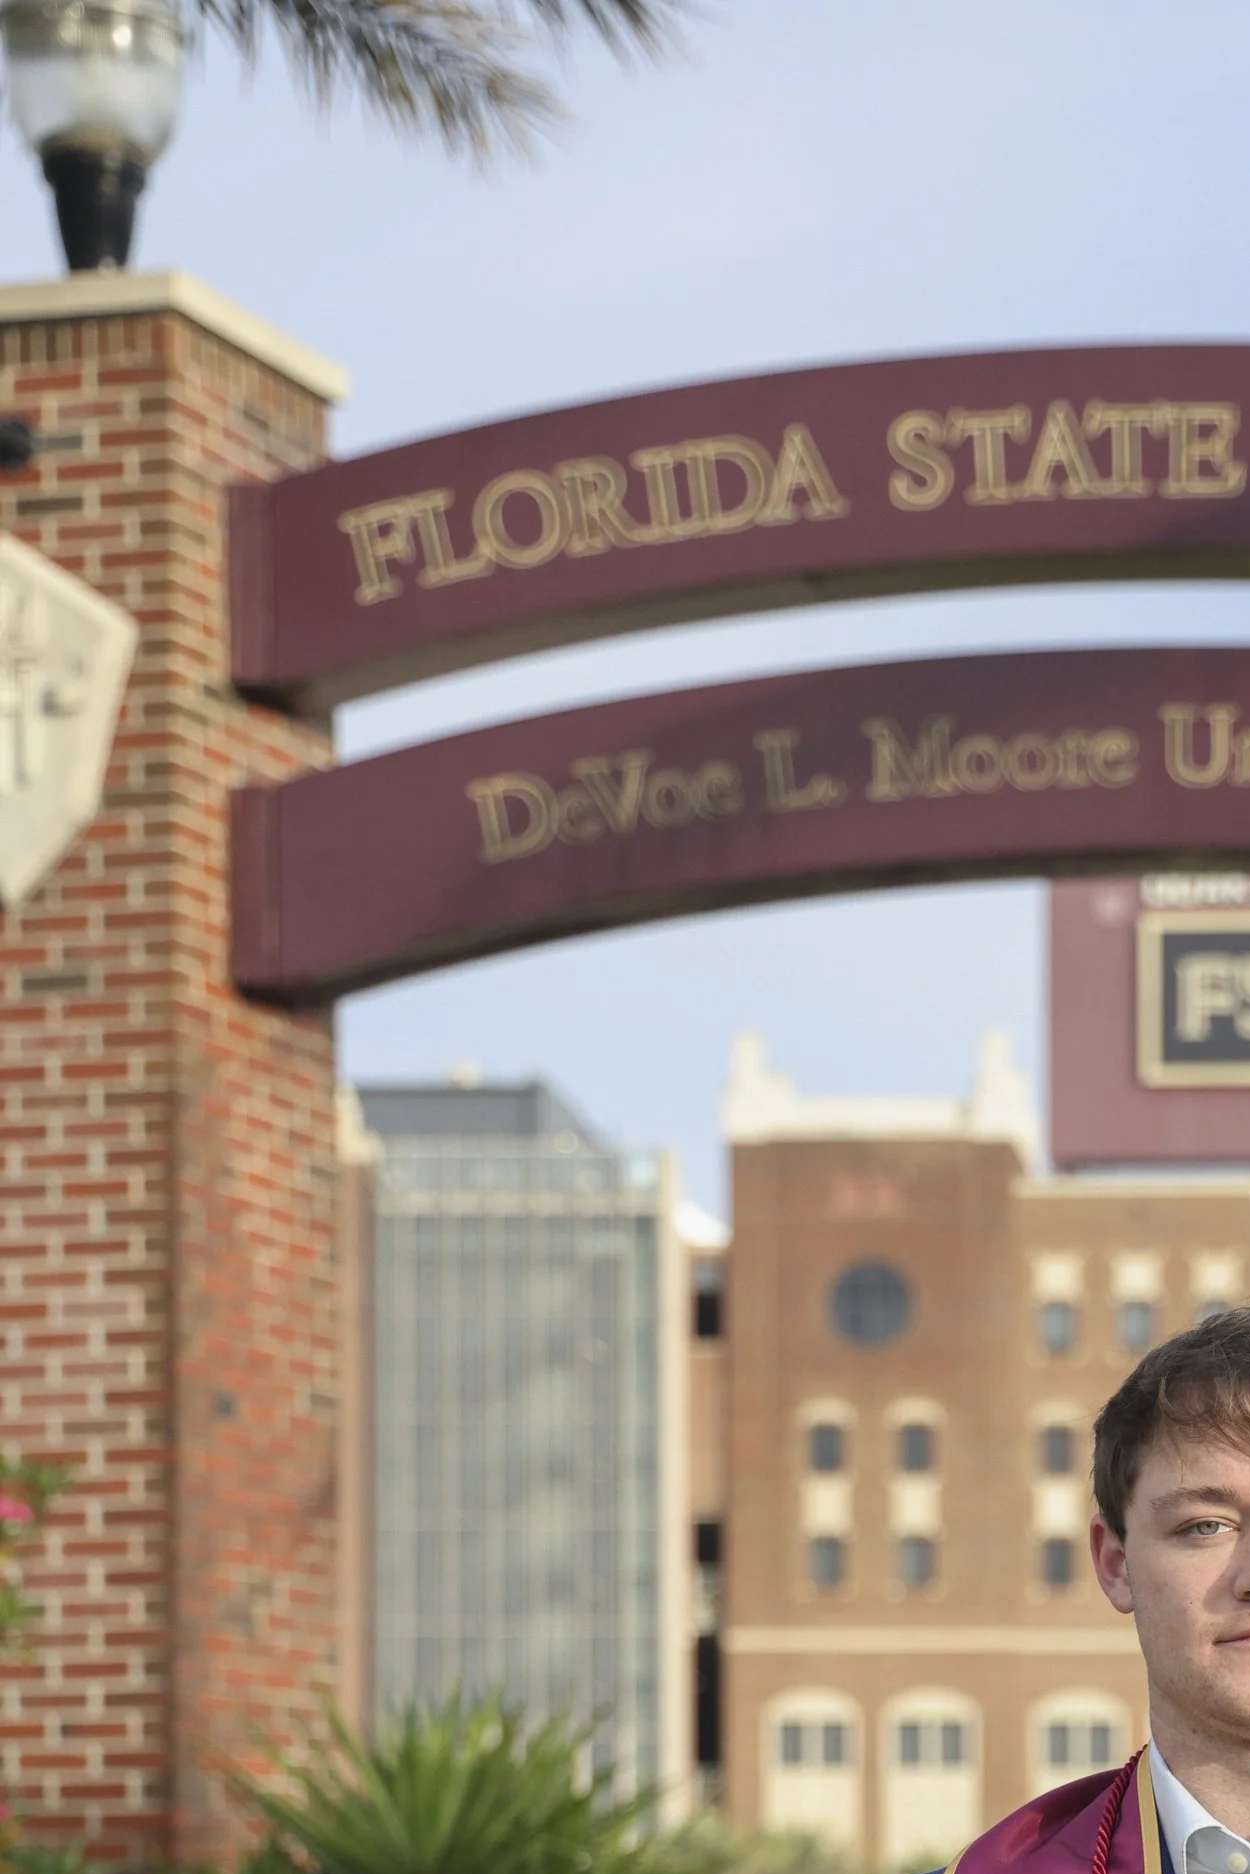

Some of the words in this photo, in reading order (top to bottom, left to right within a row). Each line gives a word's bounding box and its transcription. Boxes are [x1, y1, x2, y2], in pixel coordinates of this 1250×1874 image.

[339, 420, 850, 604] FLORIDA
[887, 397, 1247, 512] STATE
[466, 747, 741, 864] DeVoe
[753, 728, 847, 814] L.
[862, 713, 1139, 802] Moore
